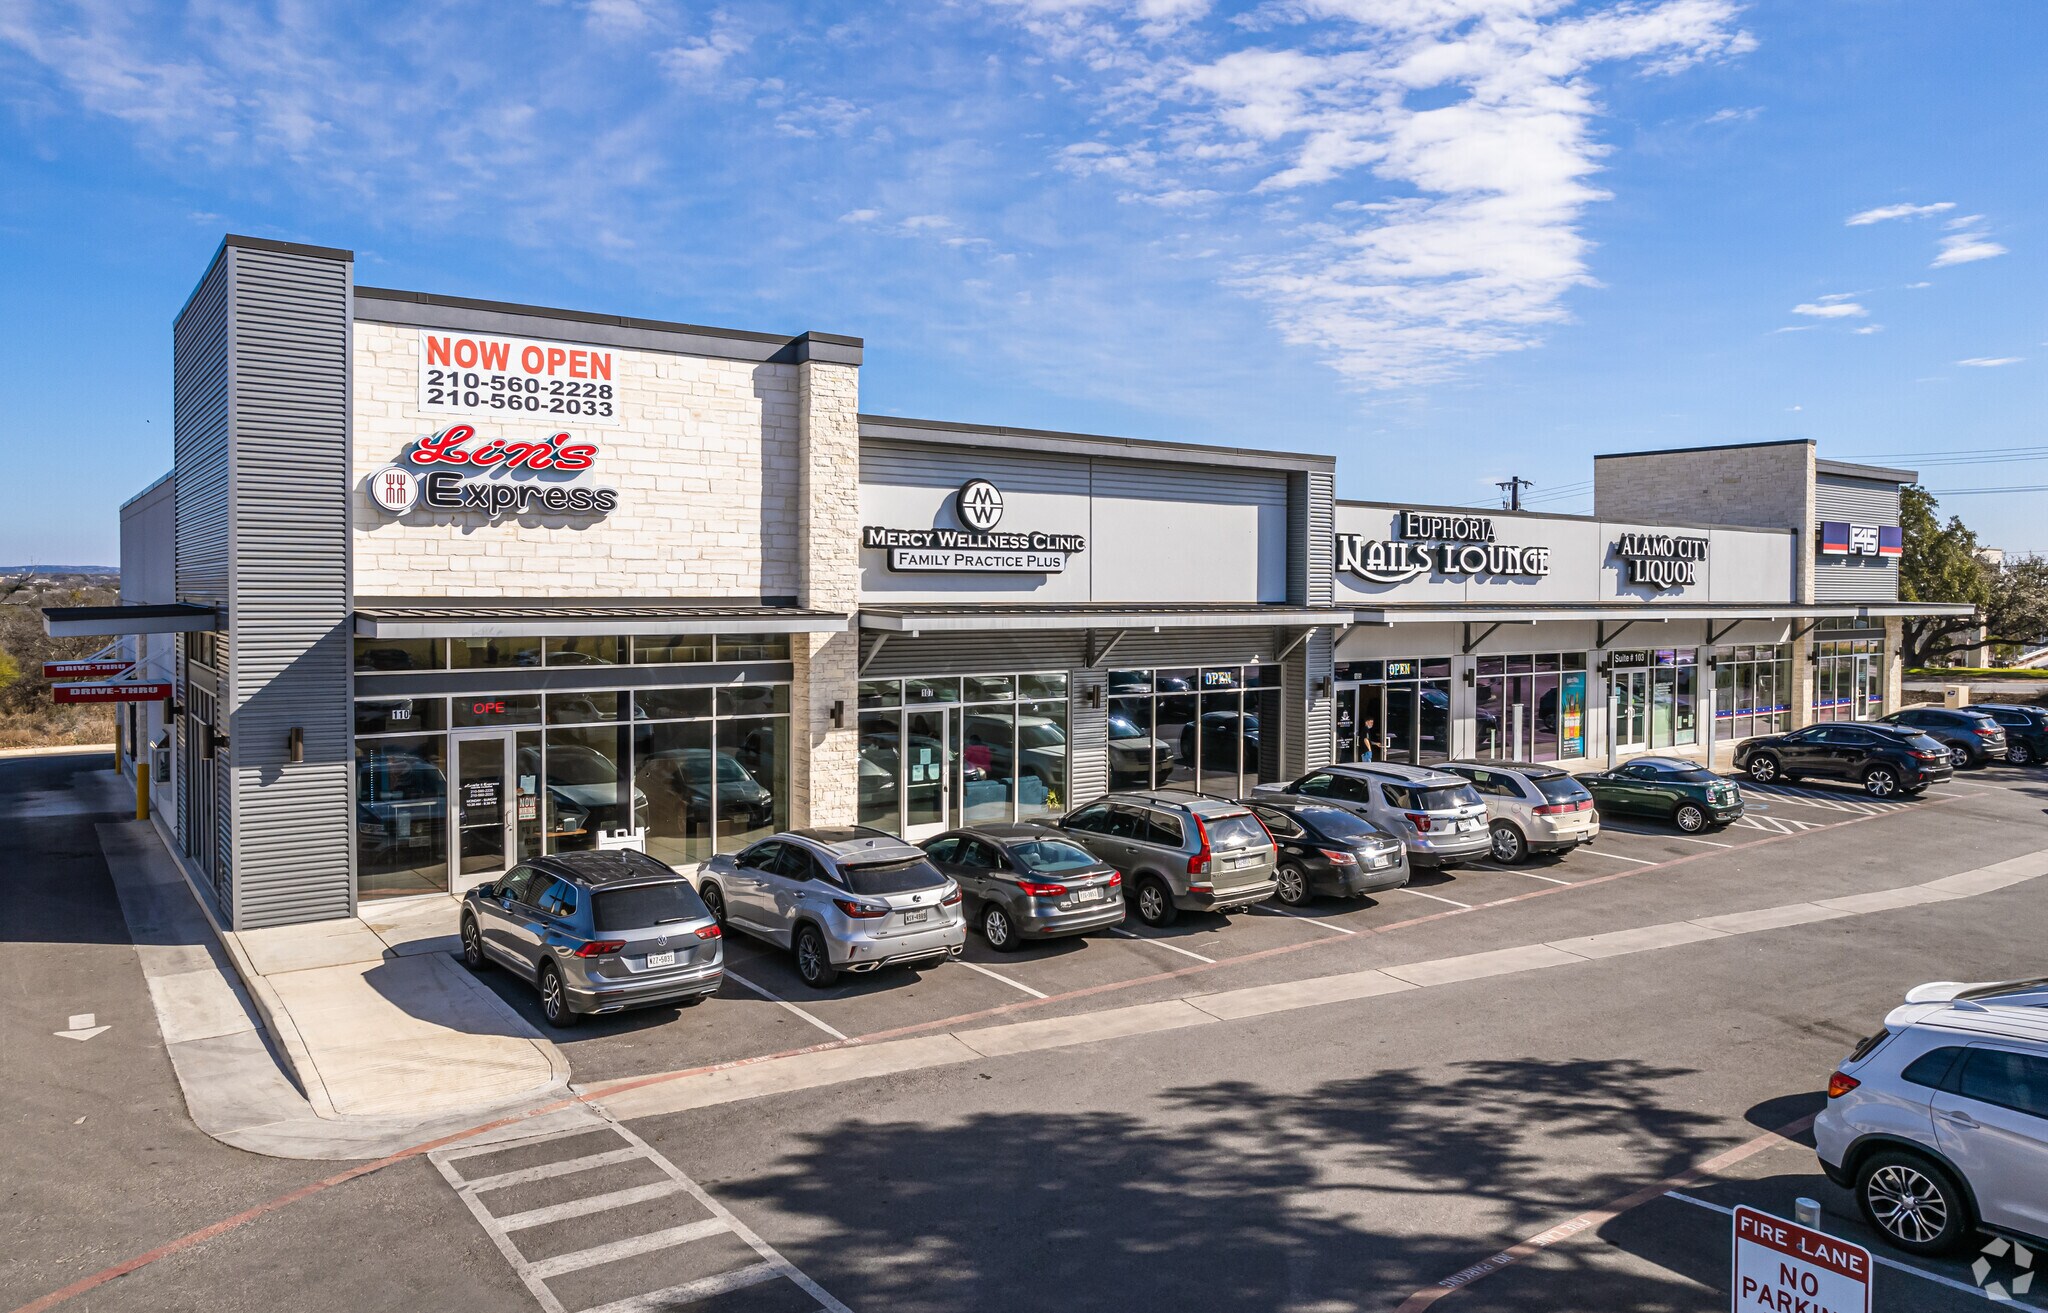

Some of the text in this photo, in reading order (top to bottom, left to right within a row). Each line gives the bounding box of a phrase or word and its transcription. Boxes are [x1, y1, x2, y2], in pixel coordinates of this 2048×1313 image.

[427, 336, 612, 381] NOW OPEN
[427, 369, 613, 400] 210-560-2228
[427, 388, 613, 417] 210-560-2033
[410, 424, 599, 470] Lin's
[426, 472, 618, 515] Express
[869, 529, 1087, 551] MERCY WELLNESS CLINIC
[1407, 512, 1498, 541] EUPHORIA
[1850, 524, 1878, 554] F45
[899, 552, 1061, 568] FAMILY PRACTICE PLUS
[1338, 535, 1551, 583] NAILS LOUNGE
[1622, 537, 1711, 559] ALAMO CITY
[1635, 560, 1697, 588] LIQUOR
[56, 664, 126, 672] DRIVE-THRU
[1389, 663, 1411, 675] OPEN
[1615, 654, 1629, 662] Suite
[1635, 653, 1645, 662] 103
[70, 686, 158, 695] DRIVE-THRU
[1205, 672, 1232, 685] OPEN
[392, 710, 410, 719] 110
[519, 797, 536, 807] NOW
[1741, 1216, 1863, 1274] FIRE LANE
[1438, 1262, 1495, 1288] PARKING
[1780, 1262, 1819, 1297] NO
[1743, 1276, 1837, 1313] PARK
